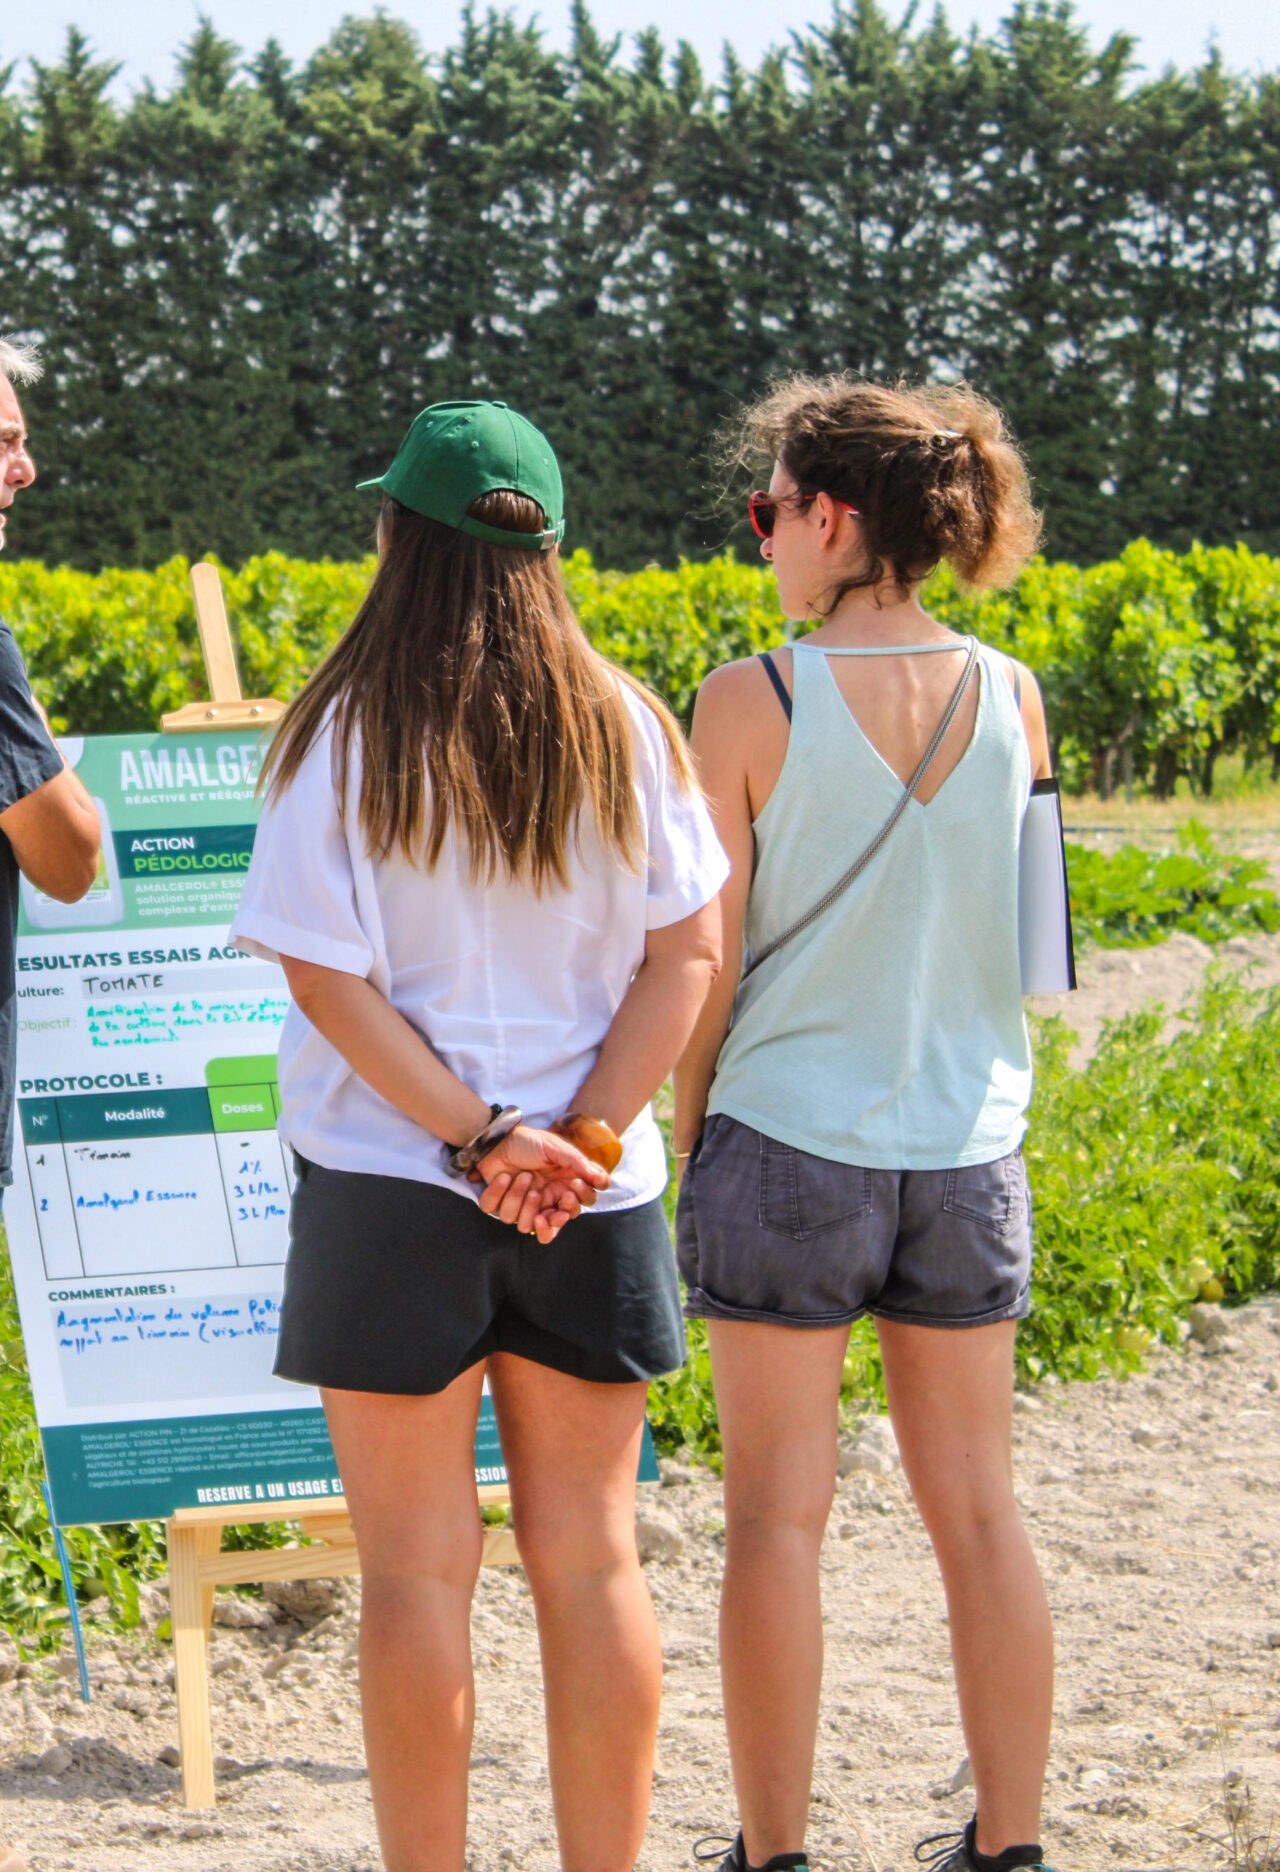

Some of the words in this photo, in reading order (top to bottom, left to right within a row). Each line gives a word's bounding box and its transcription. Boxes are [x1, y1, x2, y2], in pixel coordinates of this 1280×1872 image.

[125, 793, 186, 805] RÉACTIVE
[190, 792, 205, 802] ET
[209, 789, 266, 801] RÉÉQUI
[131, 837, 195, 852] ACTION
[136, 893, 184, 905] solution
[138, 904, 196, 916] complexe
[16, 952, 122, 972] ESULTATS
[128, 947, 201, 965] ESSAIS
[17, 986, 65, 998] ulture:
[82, 974, 164, 994] TOMATE
[20, 1072, 150, 1094] PROTOCOLE
[104, 1106, 166, 1122] Modalité
[221, 1102, 265, 1115] Doses
[48, 1283, 167, 1302] COMMENTAIRES
[197, 1485, 252, 1503] RESERVE
[255, 1484, 265, 1499] A
[267, 1483, 286, 1498] UN
[288, 1480, 329, 1496] USAGE
